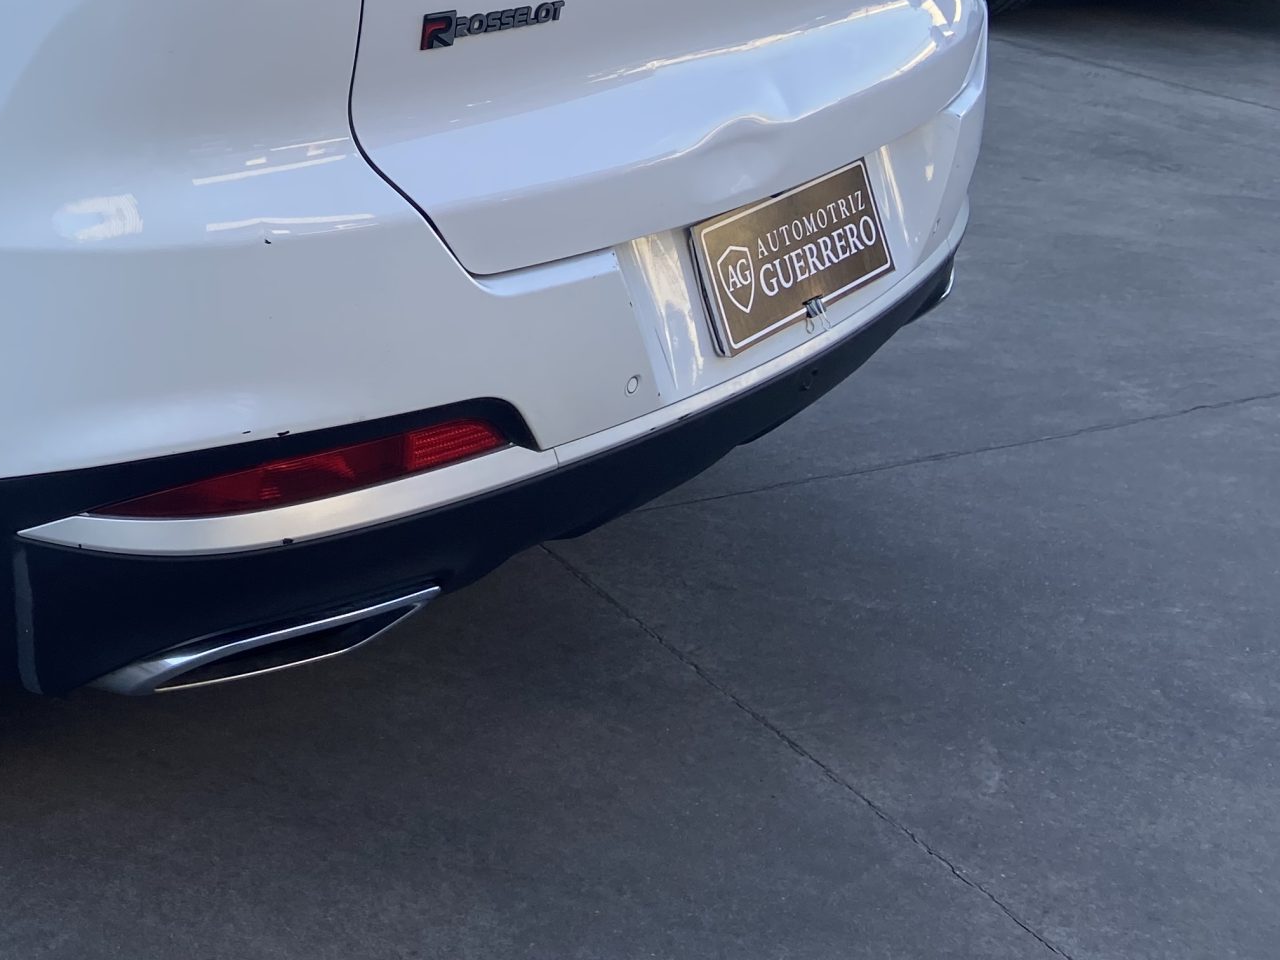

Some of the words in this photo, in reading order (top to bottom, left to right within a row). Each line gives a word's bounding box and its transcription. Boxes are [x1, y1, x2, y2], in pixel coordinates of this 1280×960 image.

[727, 258, 752, 292] AG
[759, 215, 877, 297] GUERRERO
[757, 190, 866, 259] AUTOMOTRIZ
